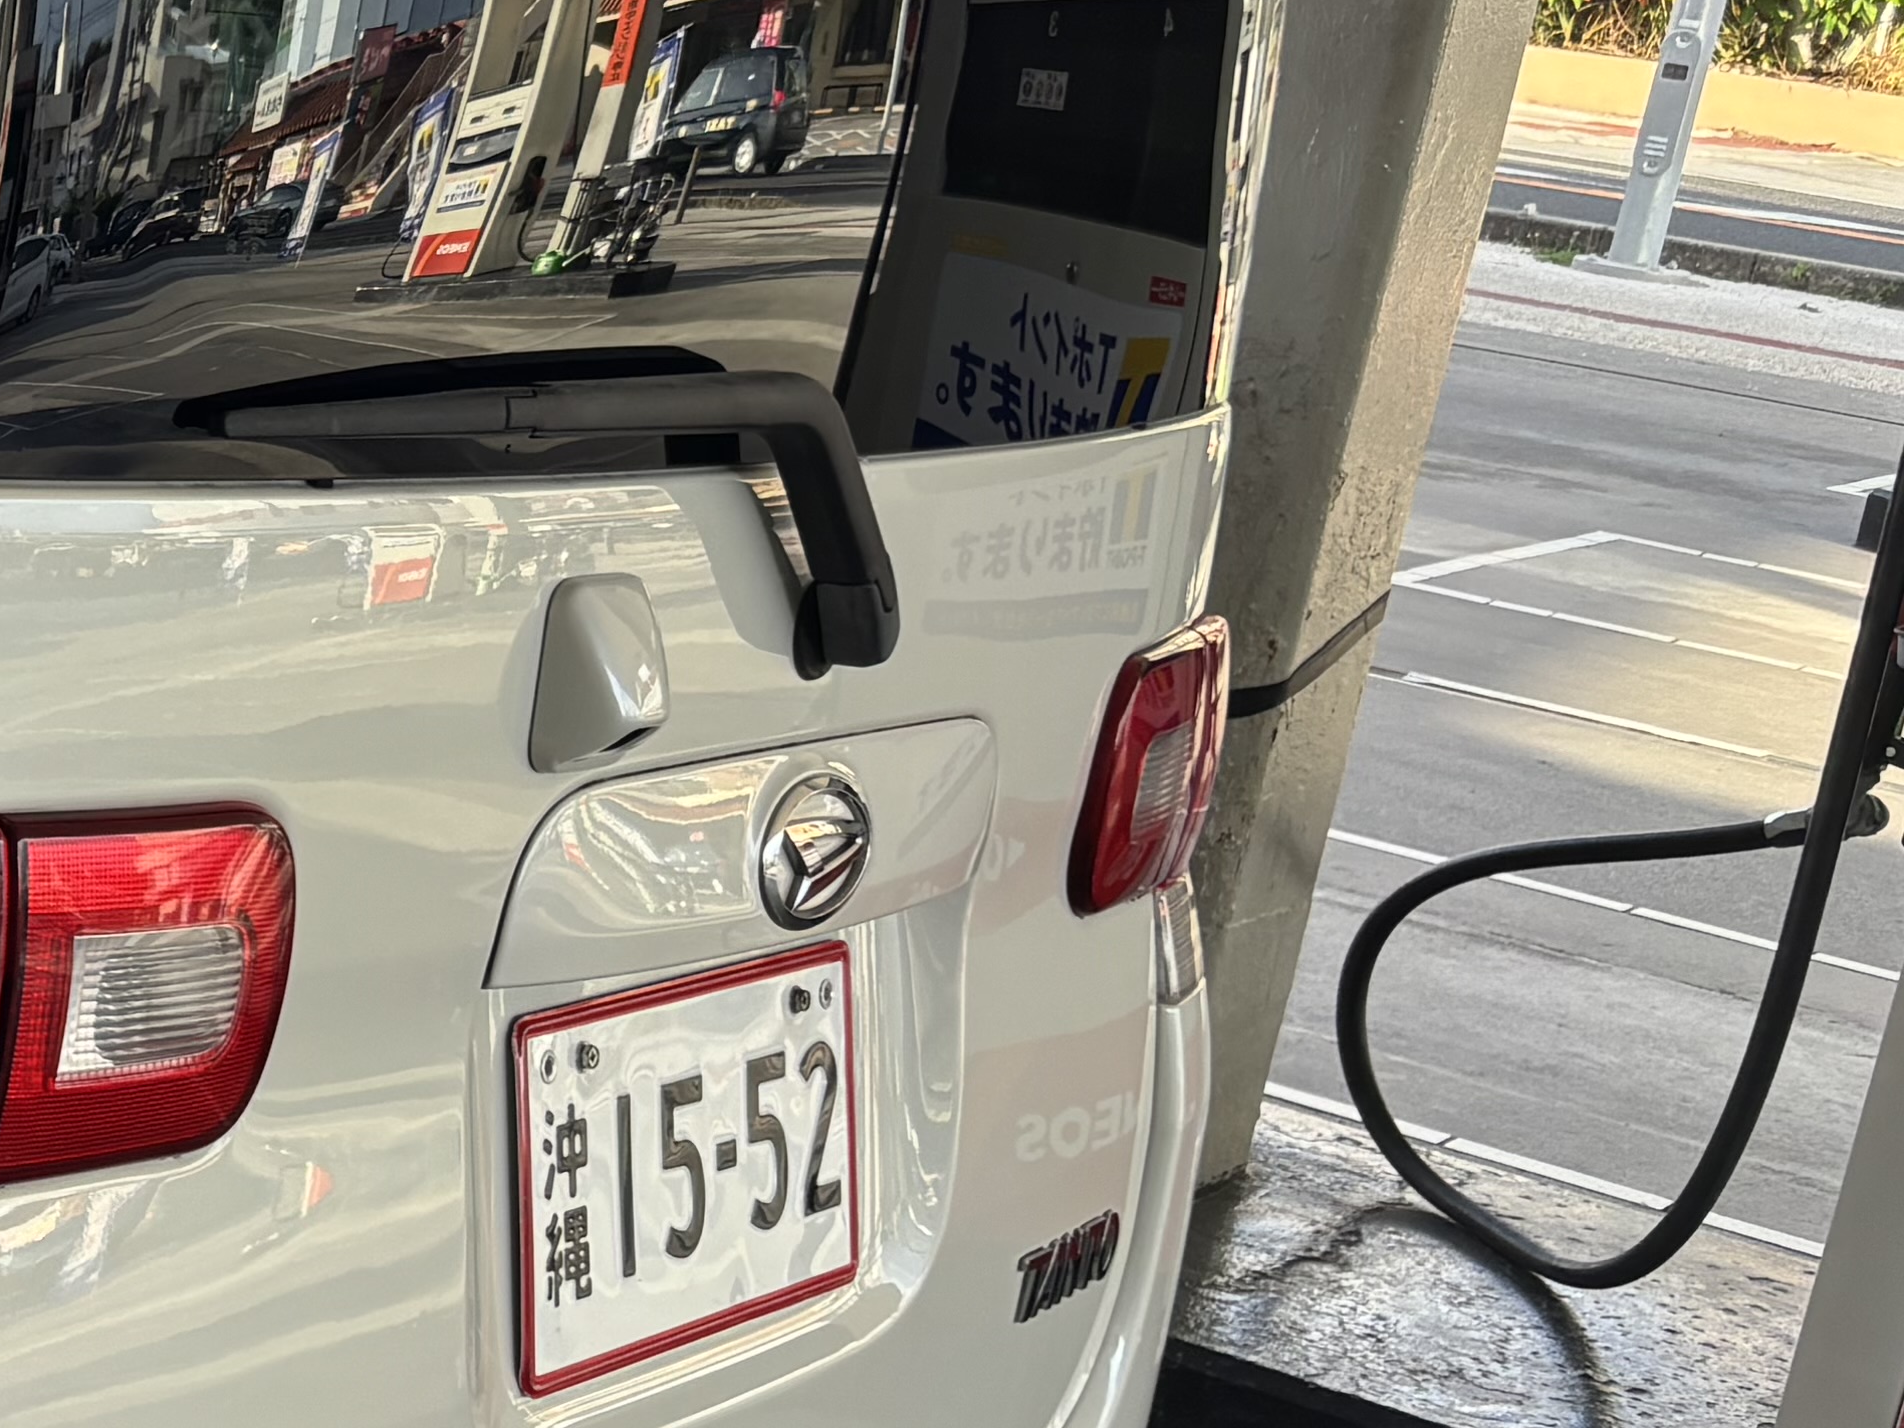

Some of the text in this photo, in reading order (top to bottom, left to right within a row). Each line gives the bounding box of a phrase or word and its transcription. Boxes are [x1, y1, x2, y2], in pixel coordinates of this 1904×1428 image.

[542, 1103, 595, 1310] 沖縄
[615, 1040, 843, 1279] 15-52
[1013, 1208, 1121, 1325] TANTO
